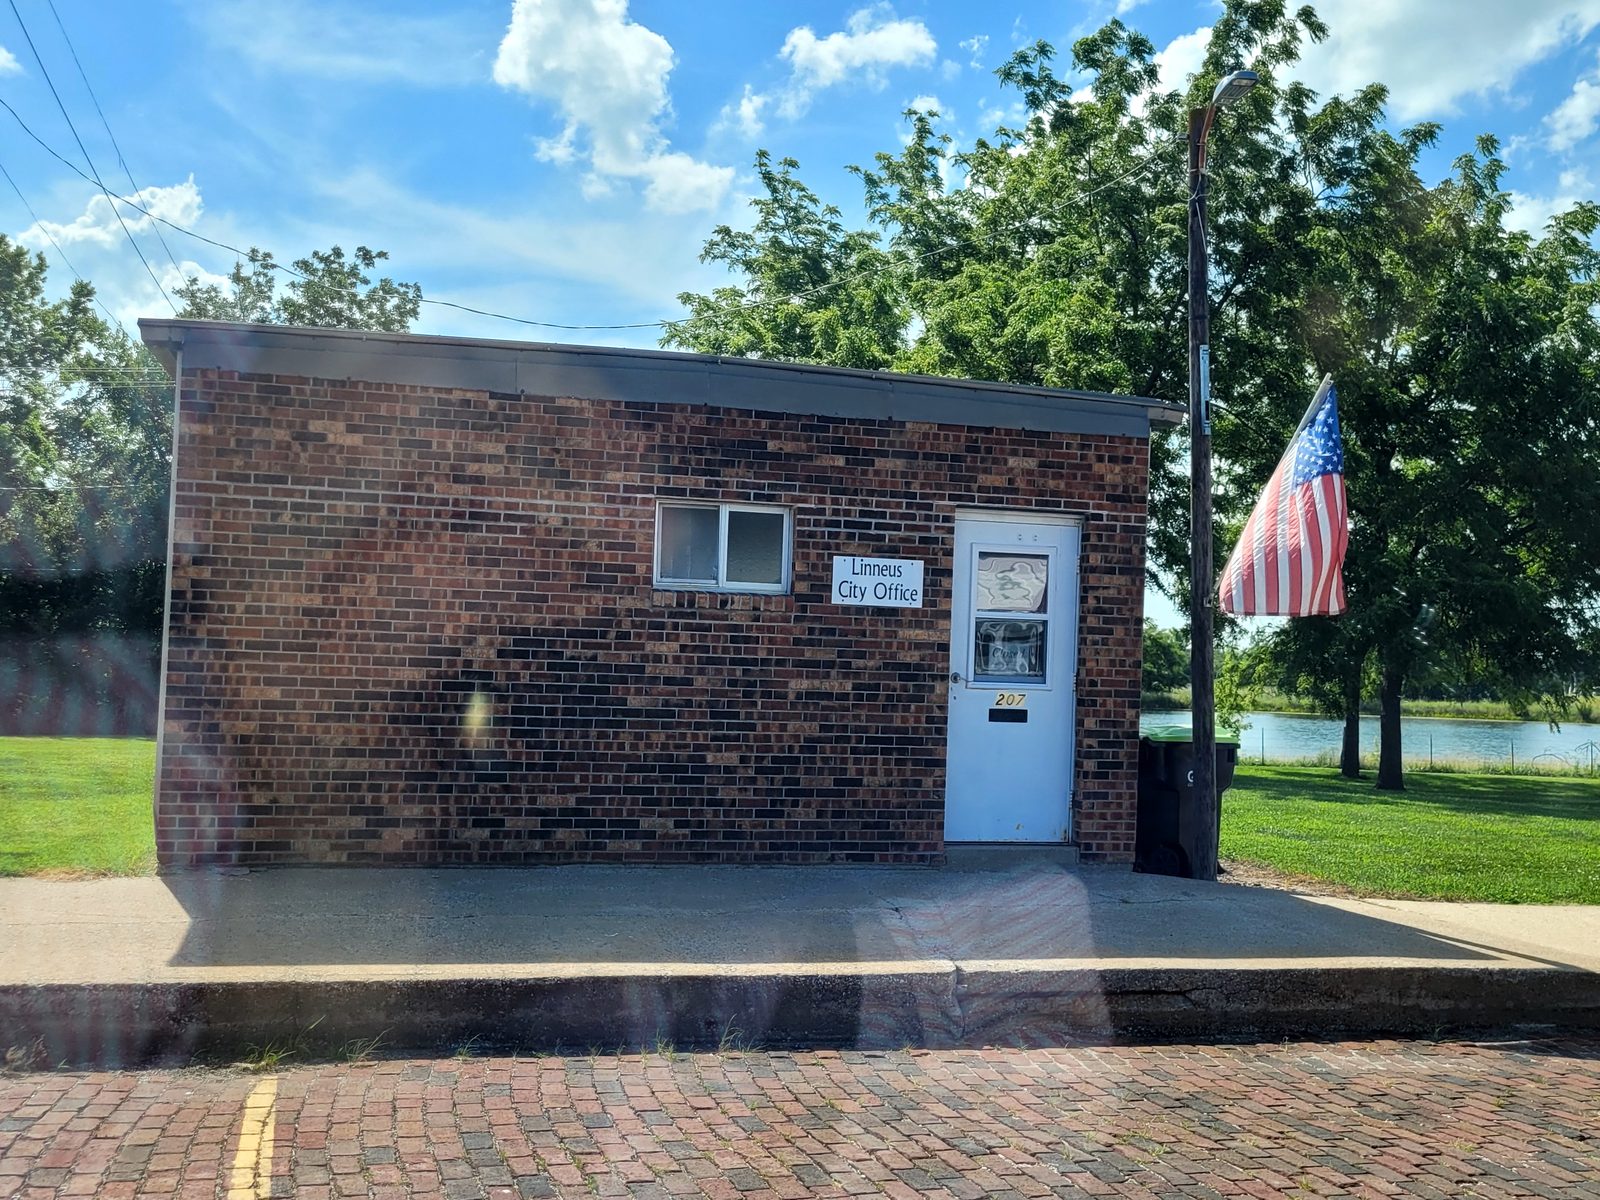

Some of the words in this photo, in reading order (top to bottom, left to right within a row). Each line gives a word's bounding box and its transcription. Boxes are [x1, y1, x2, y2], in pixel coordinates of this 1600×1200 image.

[852, 558, 902, 577] Linneus
[838, 580, 867, 602] City
[873, 582, 918, 601] Office
[995, 693, 1026, 706] 207
